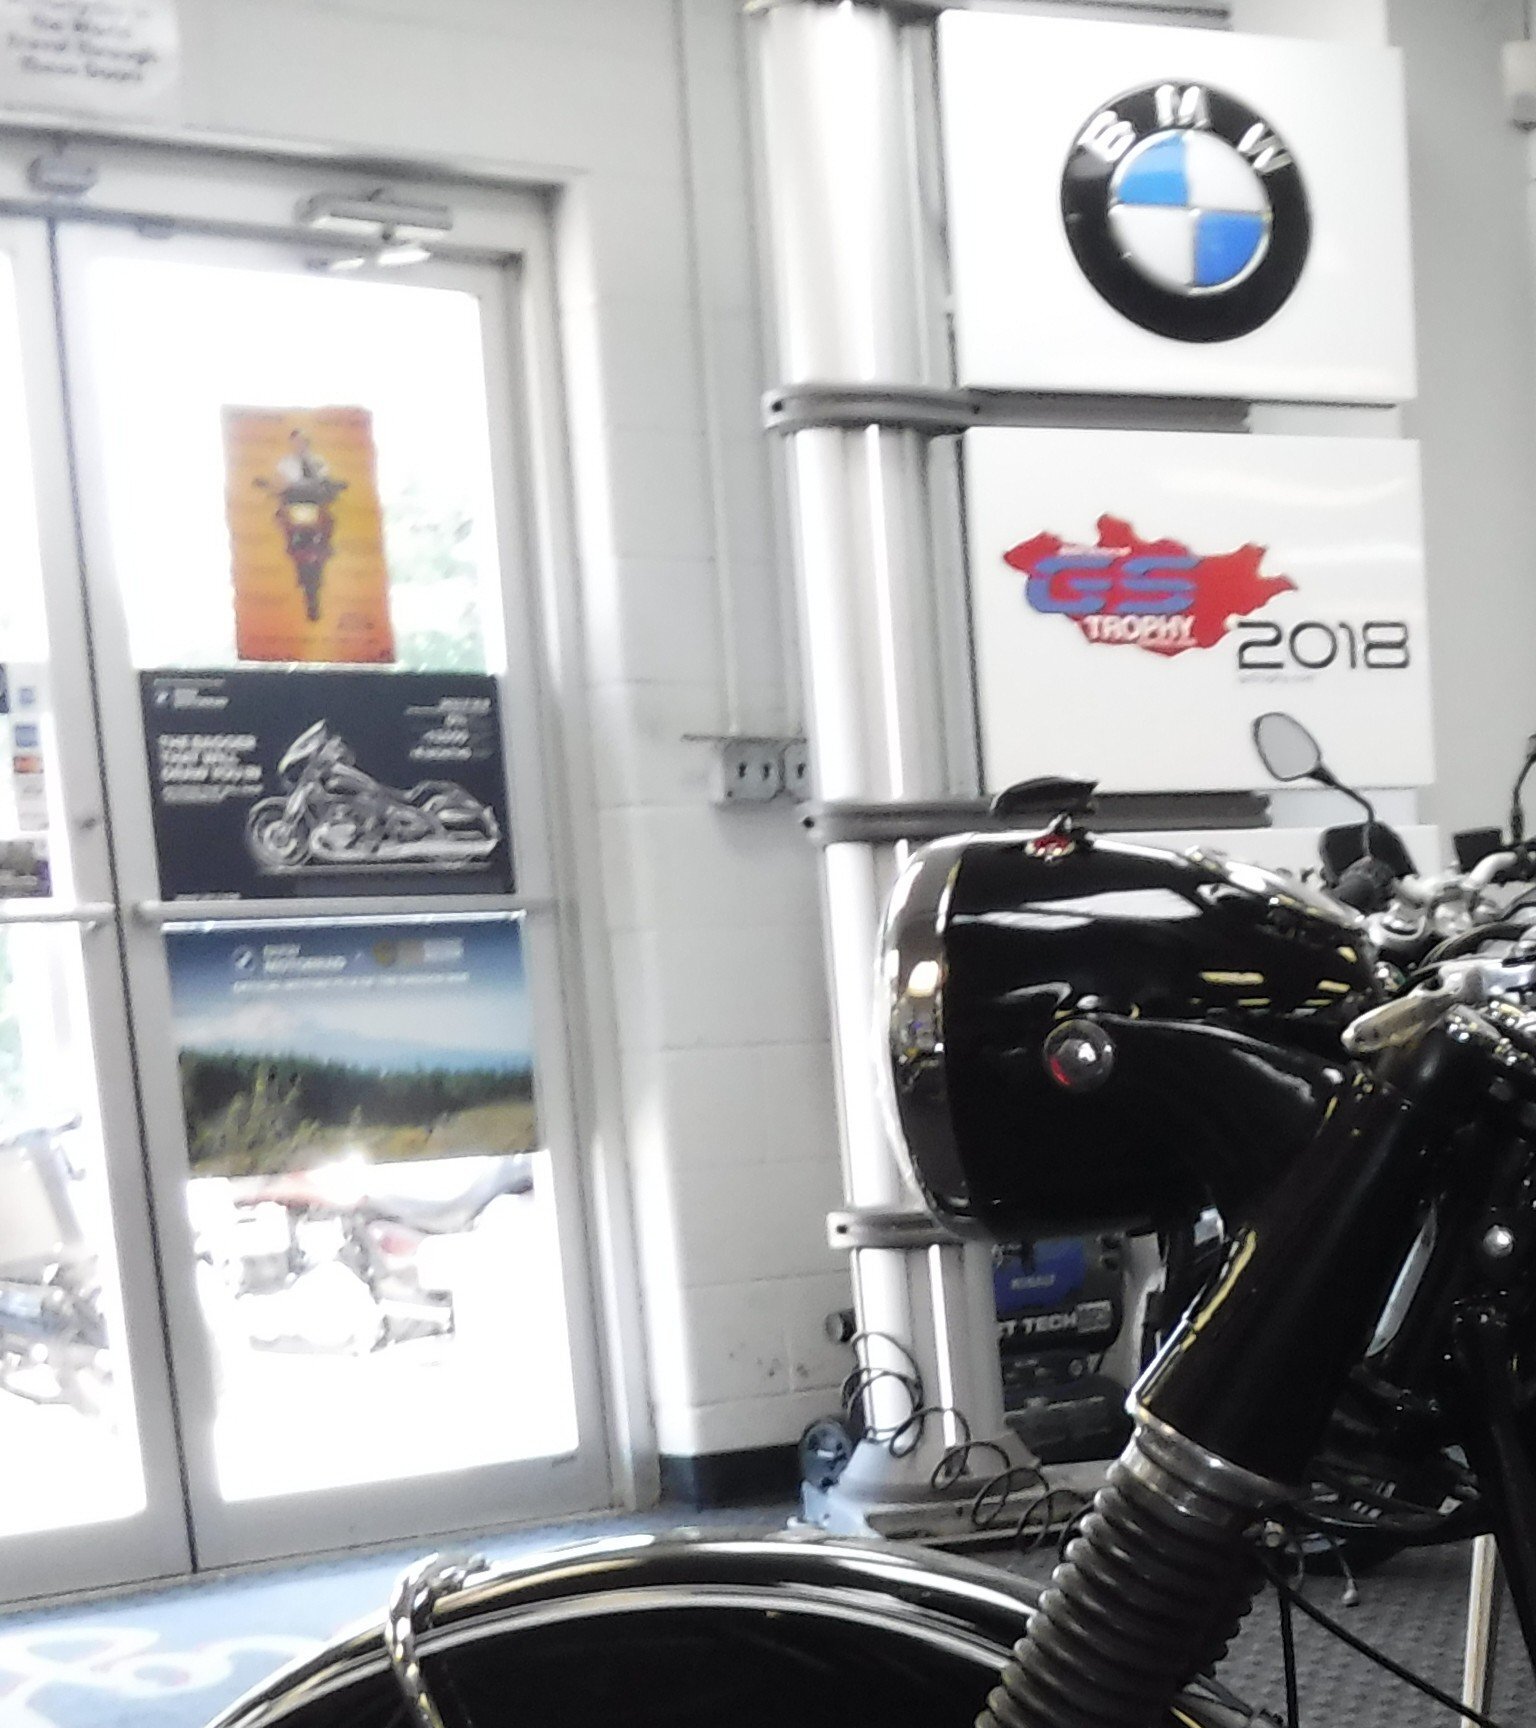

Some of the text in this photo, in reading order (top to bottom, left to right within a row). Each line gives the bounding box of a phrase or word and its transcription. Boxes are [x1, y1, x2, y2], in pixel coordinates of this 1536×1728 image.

[1077, 84, 1294, 174] BMW
[1026, 553, 1203, 614] GS
[1083, 614, 1197, 642] TROPHY
[1237, 621, 1410, 670] 2018
[1022, 1312, 1077, 1335] TECH
